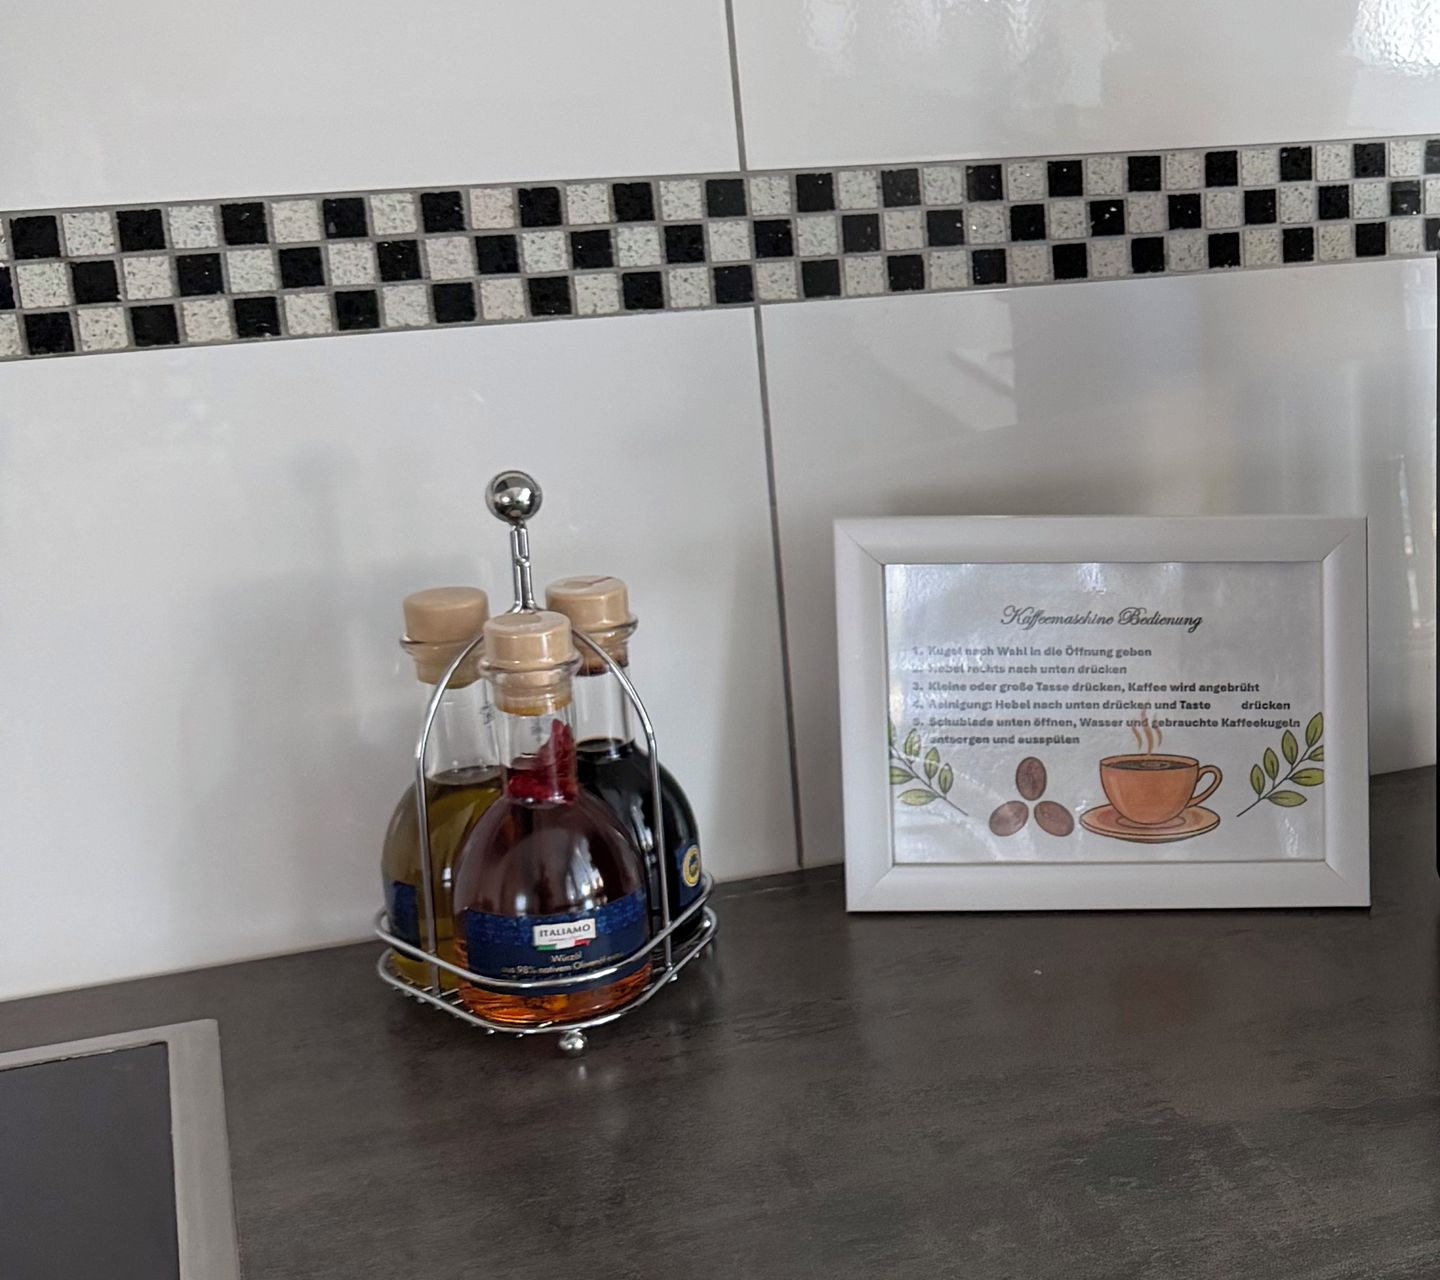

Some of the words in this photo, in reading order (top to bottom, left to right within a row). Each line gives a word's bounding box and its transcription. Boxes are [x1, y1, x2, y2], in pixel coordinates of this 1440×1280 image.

[1000, 605, 1113, 630] Kaffeemaschine
[1118, 606, 1203, 632] Bedienung
[996, 646, 1028, 657] Wahl
[1030, 646, 1041, 657] in
[1043, 646, 1062, 657] die
[1065, 644, 1113, 660] Öffnung
[1116, 646, 1152, 660] geben
[1008, 664, 1037, 675] nach
[1040, 664, 1076, 675] unten
[1078, 664, 1127, 675] drücken
[912, 682, 924, 692] 3.
[928, 682, 966, 692] Kleine
[969, 682, 998, 692] oder
[999, 682, 1034, 695] große
[1036, 682, 1069, 692] Tasse
[1071, 681, 1125, 694] drücken,
[1128, 681, 1167, 693] Kaffee
[1170, 681, 1196, 693] wird
[1199, 681, 1260, 695] angebrüht
[995, 699, 1030, 710] Hebel
[1033, 699, 1062, 710] nach
[1065, 700, 1100, 710] unten
[1103, 699, 1152, 710] drücken
[1154, 700, 1177, 710] und
[1179, 700, 1211, 710] Taste
[1241, 699, 1290, 711] drücken
[929, 717, 994, 728] Schublade
[996, 718, 1031, 728] unten
[1034, 717, 1077, 730] öffnen,
[1079, 717, 1123, 728] Wasser
[1126, 717, 1148, 728] und
[1151, 717, 1219, 730] gebrauchte
[1221, 717, 1300, 731] Kaffeekugeln
[992, 735, 1014, 745] und
[1017, 734, 1080, 748] ausspülen
[539, 924, 591, 937] ITALIAMO
